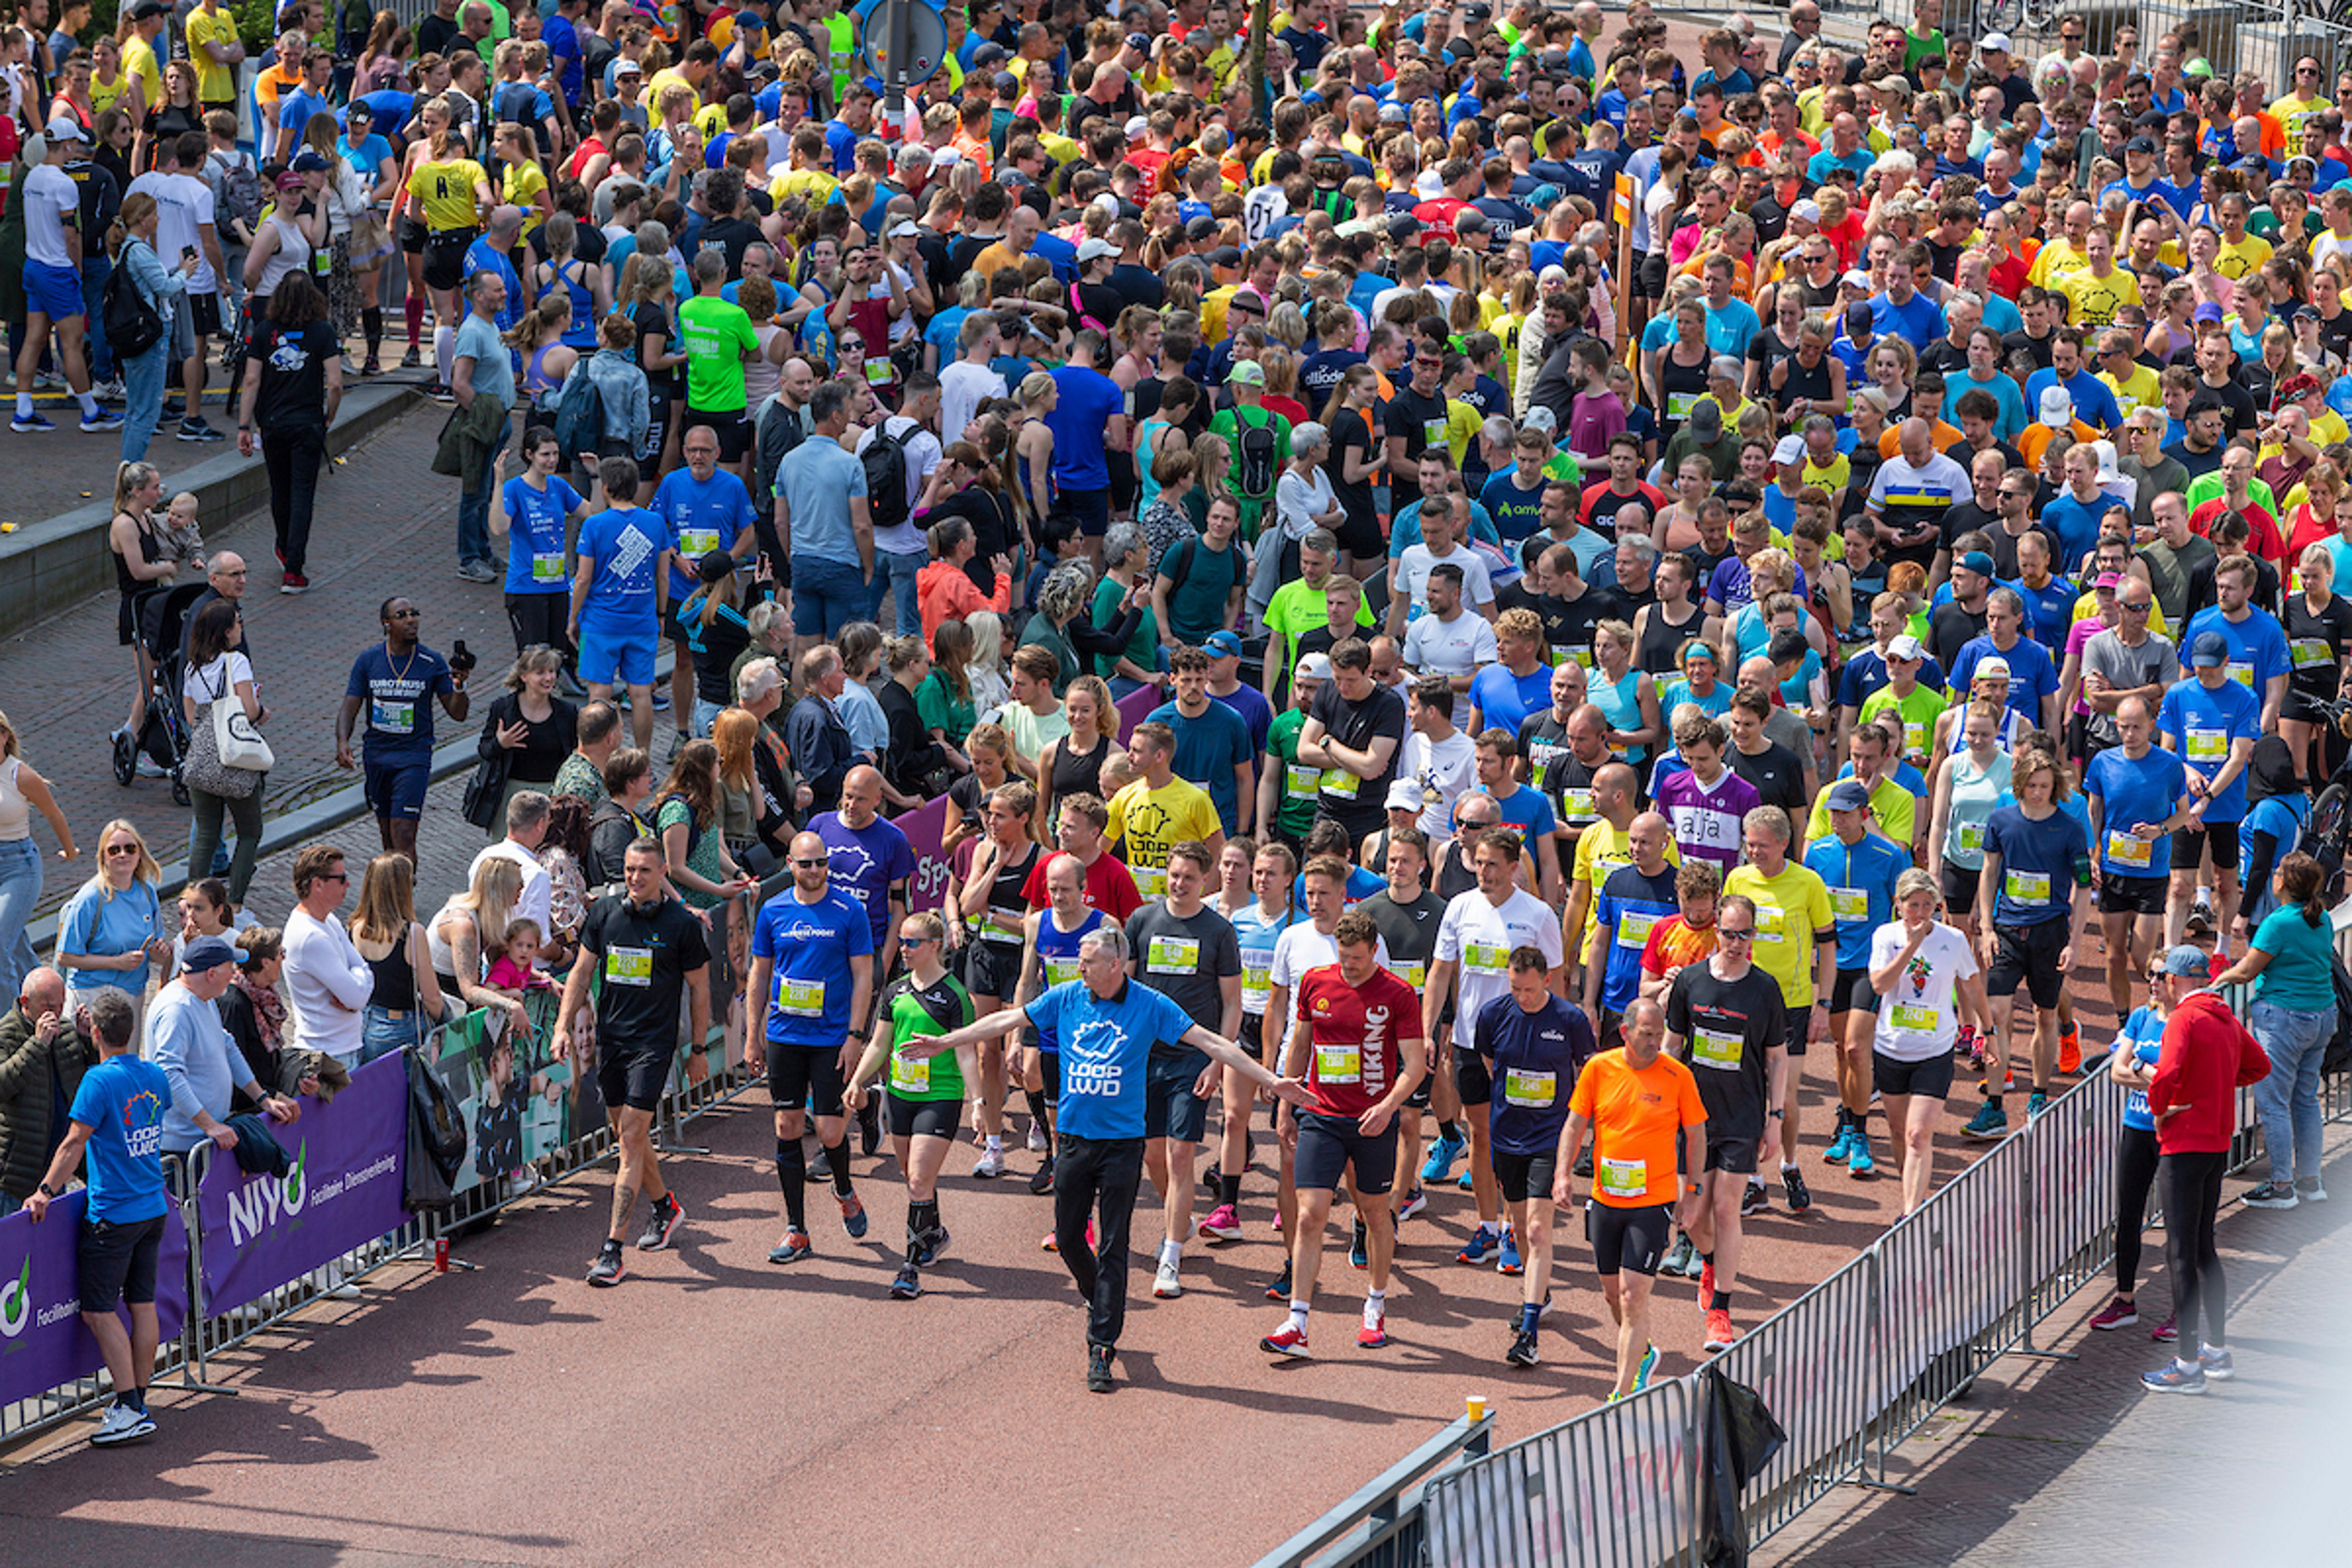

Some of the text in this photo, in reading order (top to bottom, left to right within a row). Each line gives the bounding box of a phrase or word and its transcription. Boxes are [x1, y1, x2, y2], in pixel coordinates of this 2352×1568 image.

[1130, 840, 1169, 852] LOOP
[1363, 1005, 1389, 1096] VIKING
[1068, 1061, 1122, 1079] LOOP
[1067, 1075, 1121, 1096] LWD
[228, 1161, 306, 1246] NIYO
